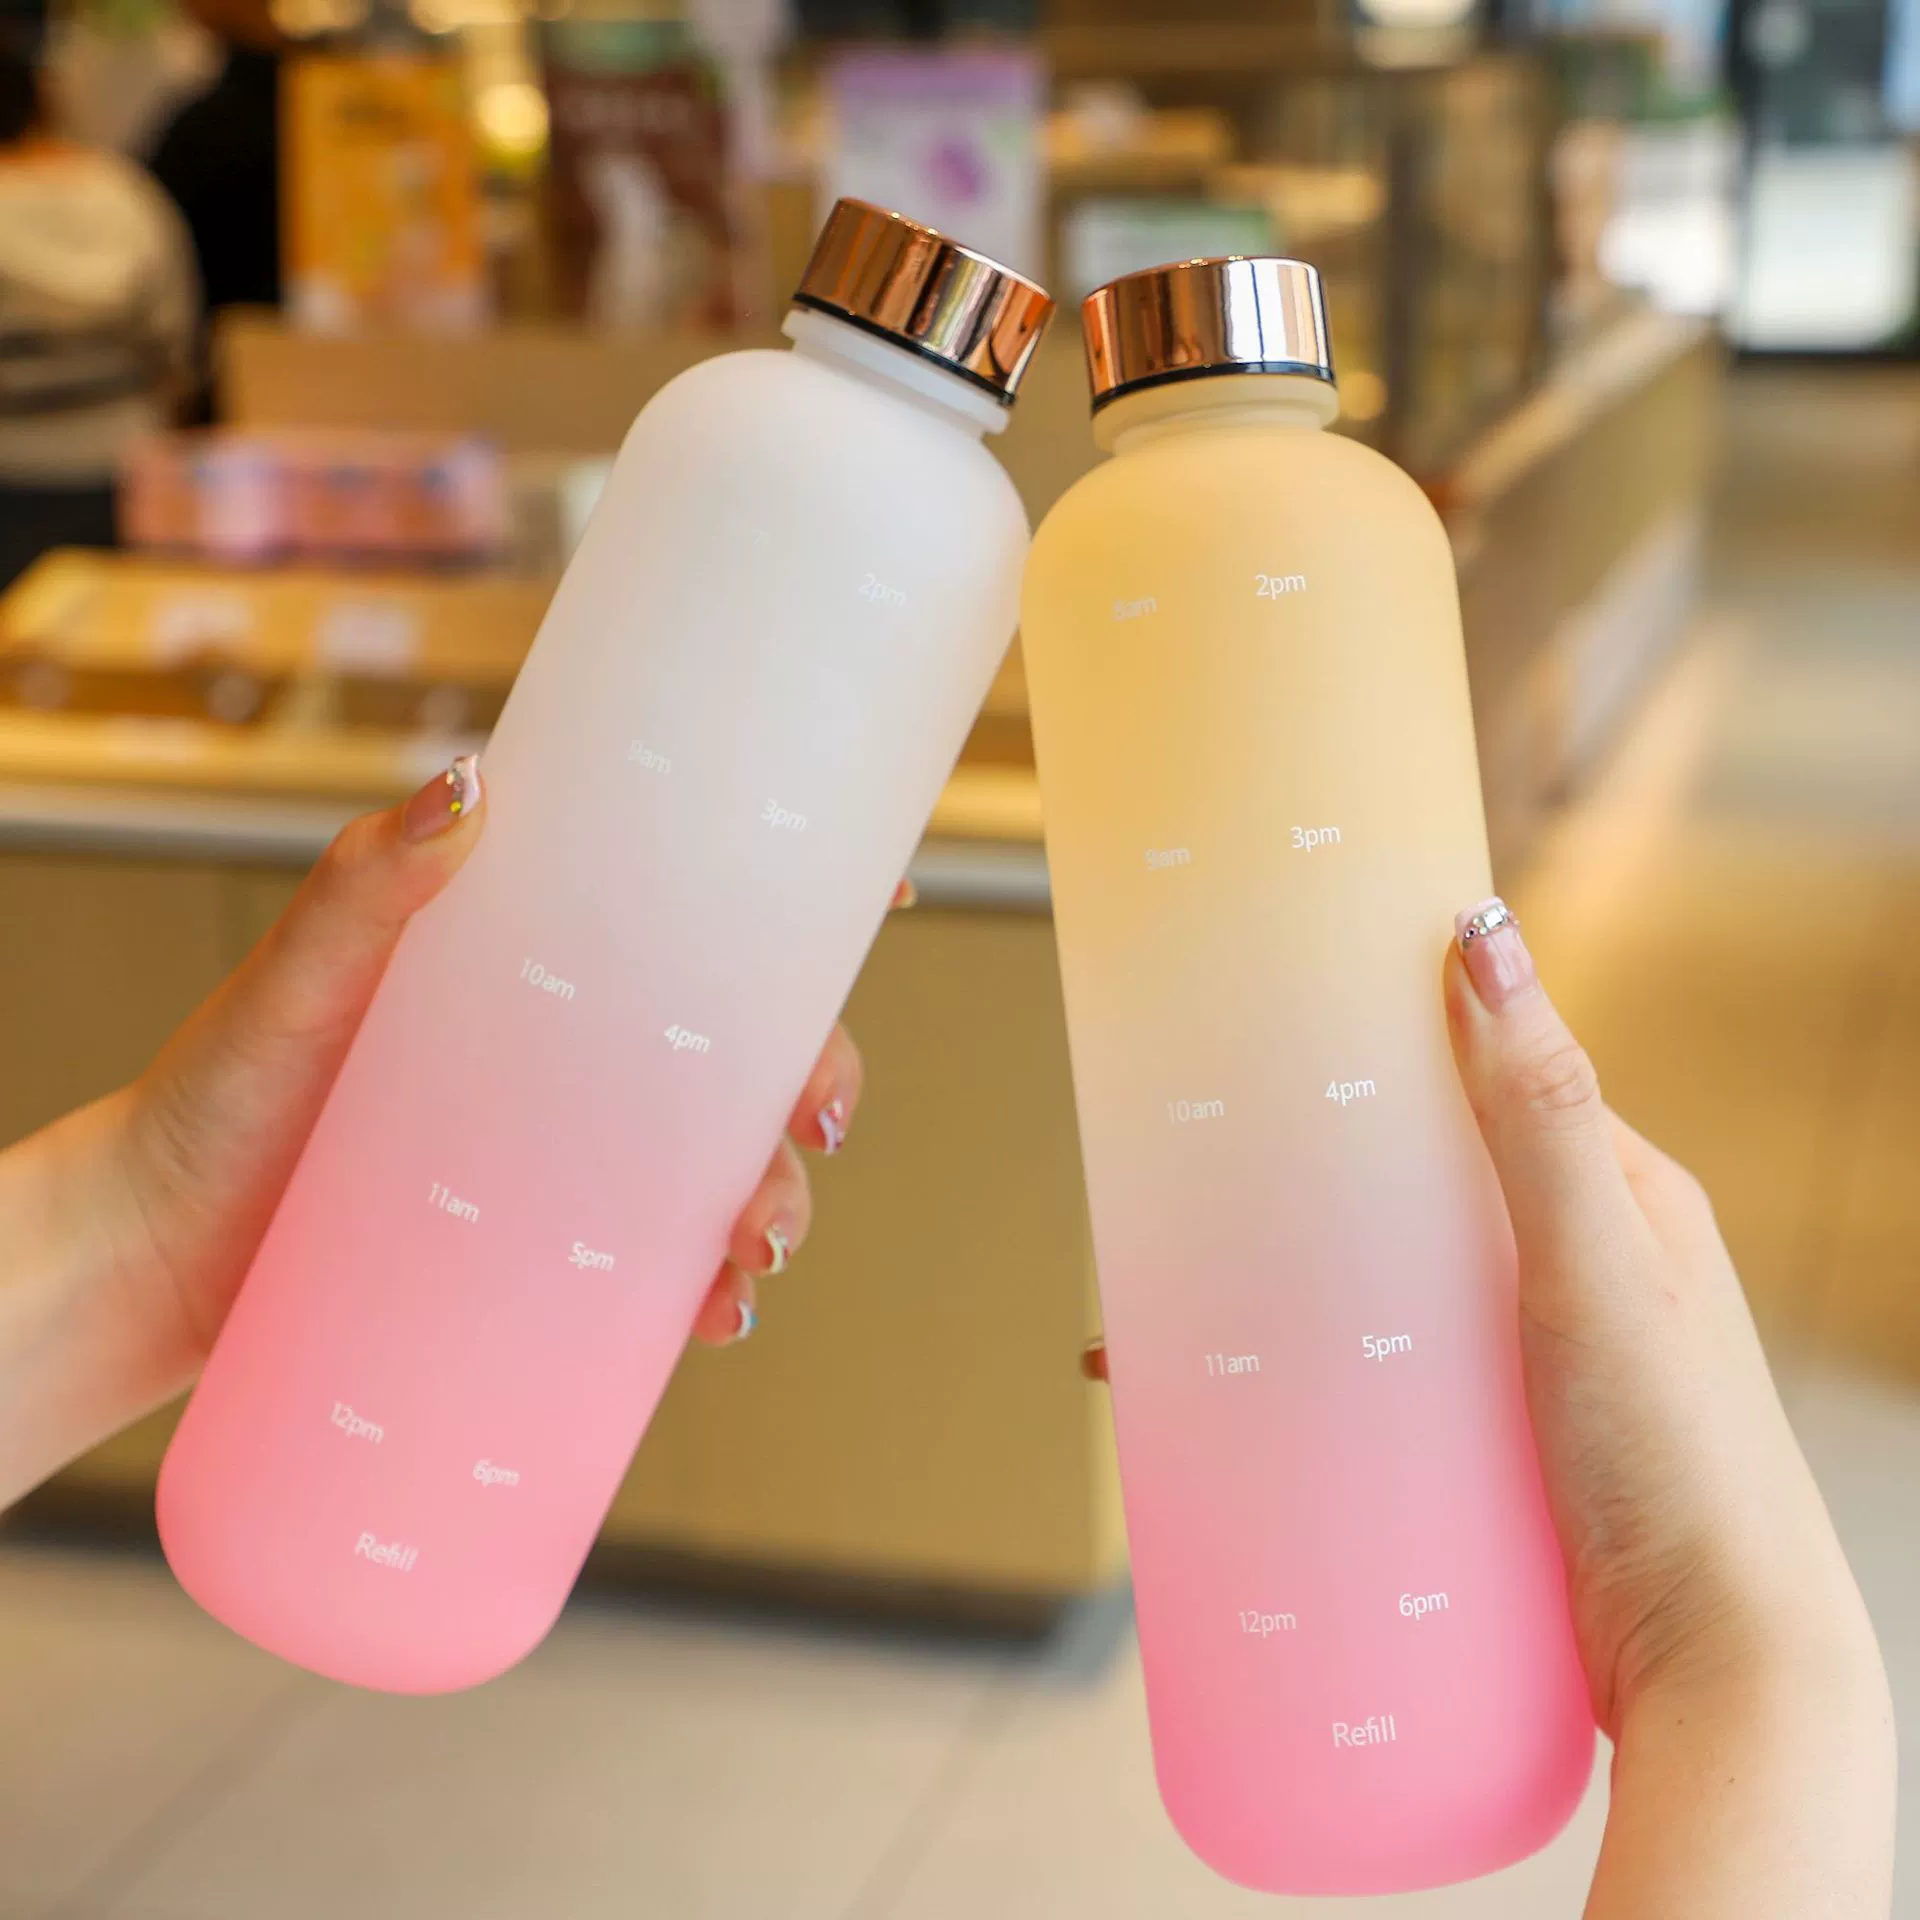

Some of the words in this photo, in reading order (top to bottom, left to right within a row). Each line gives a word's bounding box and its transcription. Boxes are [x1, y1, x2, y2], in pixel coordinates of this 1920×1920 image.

[857, 572, 907, 608] 2pm
[1254, 574, 1307, 601] 2pm
[760, 798, 808, 832] 3pm
[1290, 825, 1341, 853] 3pm
[520, 958, 576, 1001] 10am
[663, 1024, 711, 1053] 4pm
[1325, 1079, 1377, 1107] 4pm
[1167, 1098, 1226, 1124] 10am
[428, 1182, 480, 1223] 11am
[567, 1241, 615, 1270] 5pm
[1362, 1334, 1412, 1362] 5pm
[1205, 1353, 1260, 1376] 11am
[331, 1401, 384, 1443] 12pm
[472, 1459, 520, 1487] 6pm
[354, 1531, 419, 1572] Refill
[1399, 1592, 1449, 1621] 6pm
[1238, 1610, 1297, 1638] 12pm
[1332, 1714, 1396, 1748] Refill
